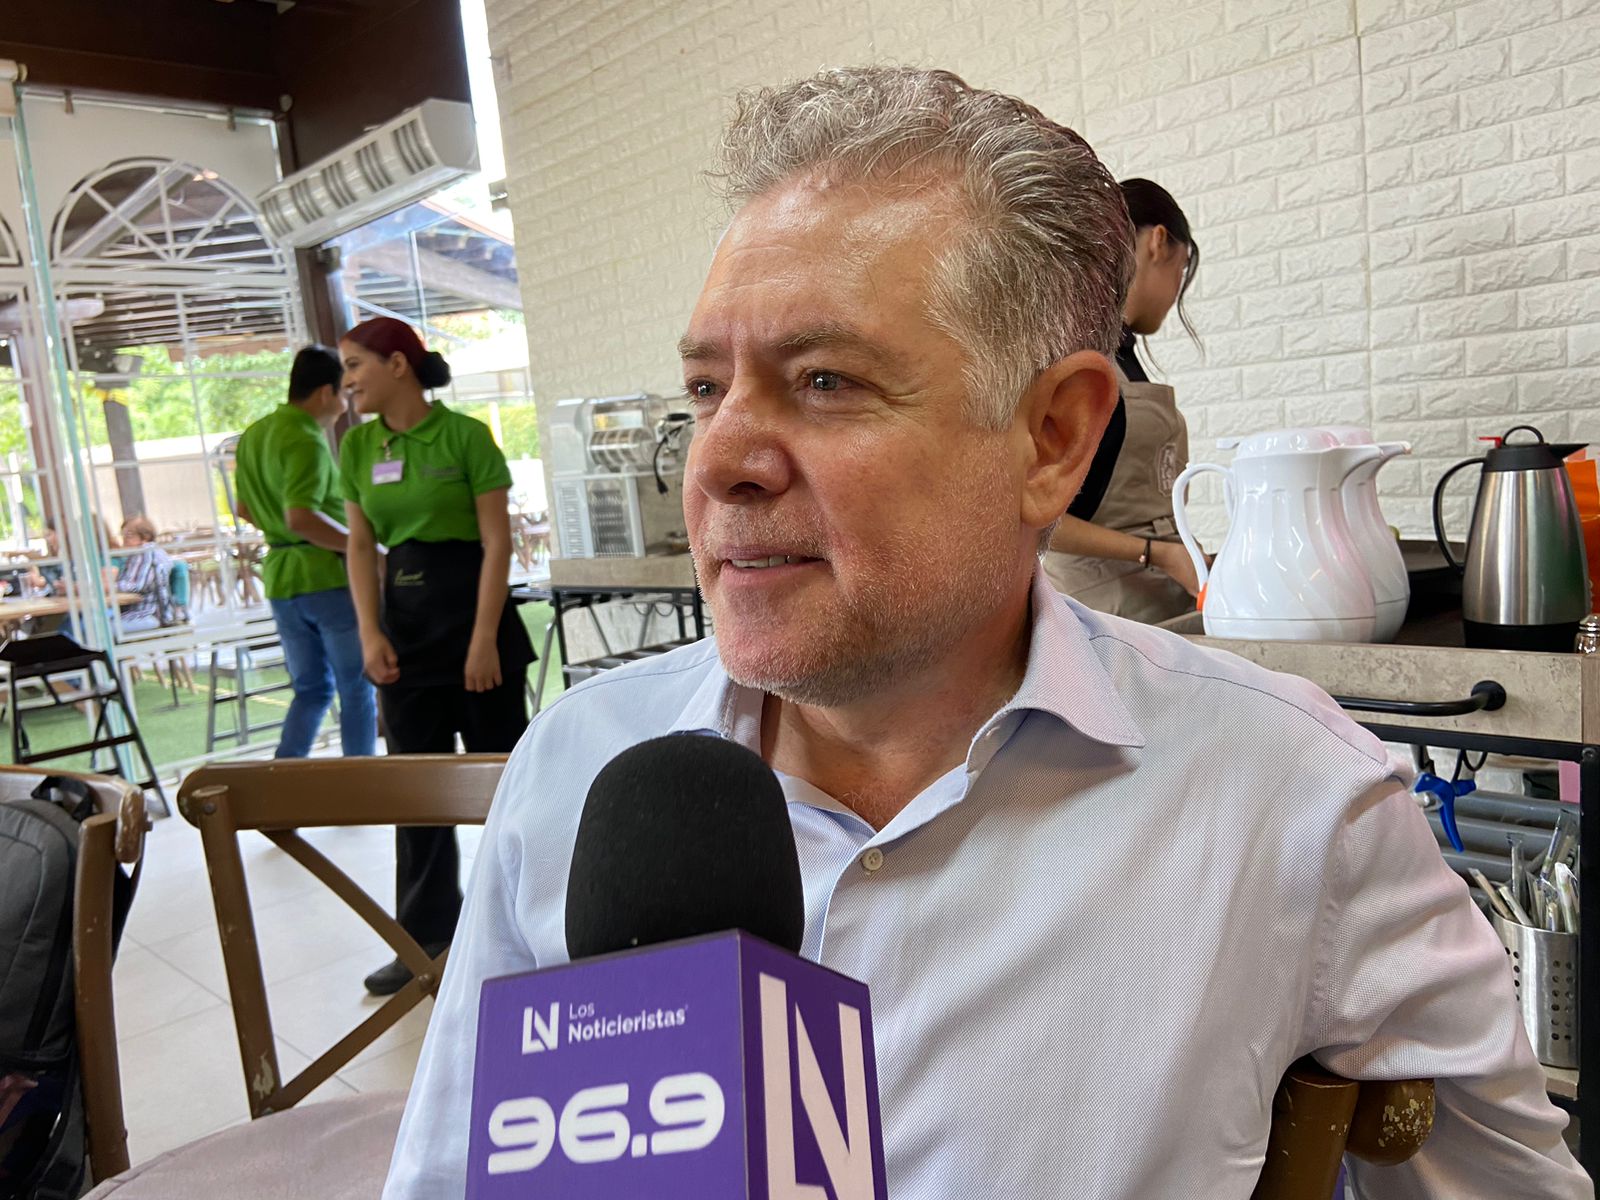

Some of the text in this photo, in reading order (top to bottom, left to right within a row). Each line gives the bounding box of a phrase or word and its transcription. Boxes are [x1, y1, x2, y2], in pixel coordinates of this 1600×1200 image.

[568, 1008, 686, 1044] Noticieristas
[569, 1002, 595, 1020] Los
[488, 1071, 725, 1174] 96.9
